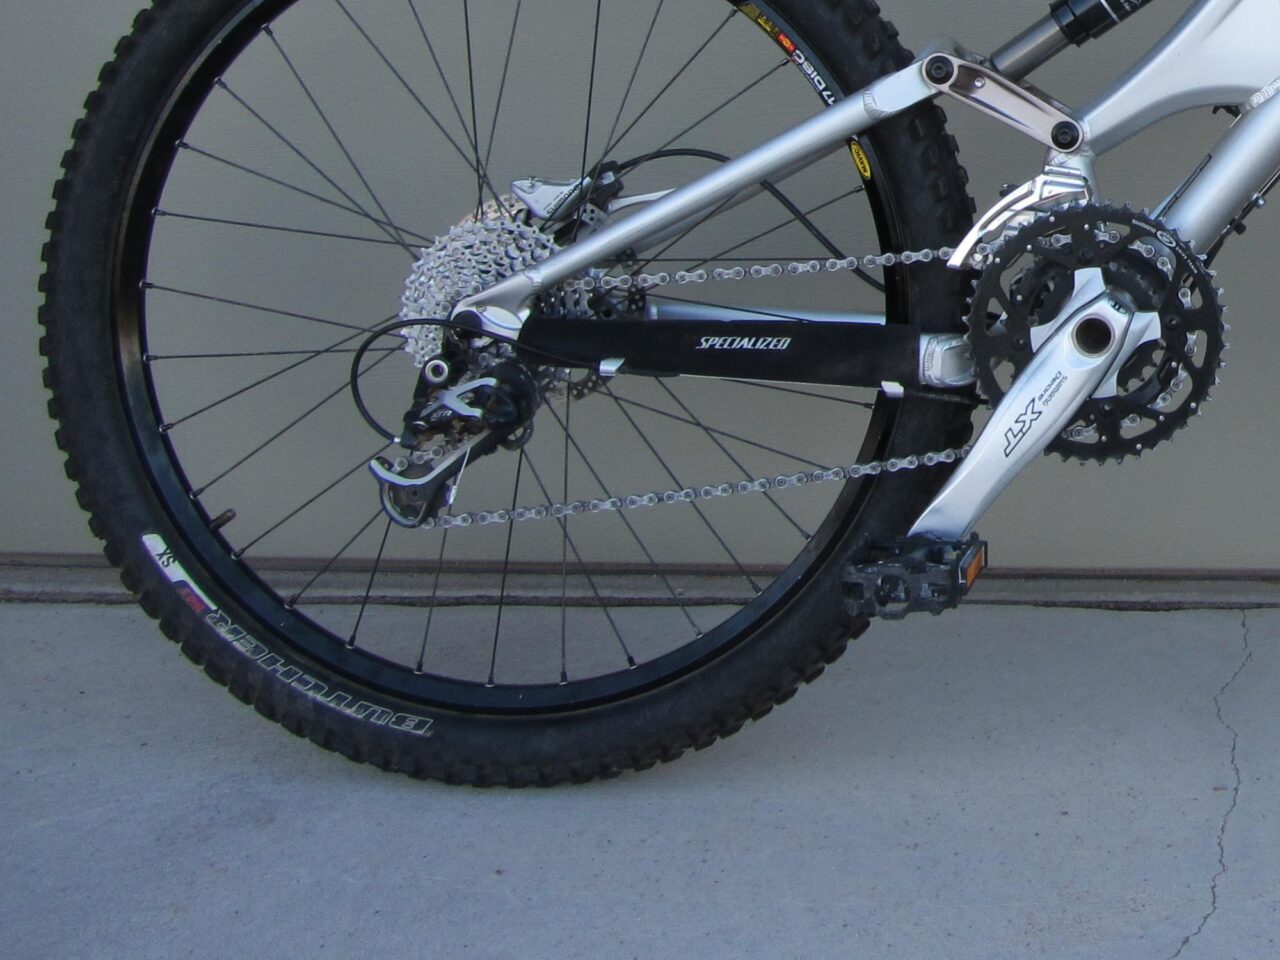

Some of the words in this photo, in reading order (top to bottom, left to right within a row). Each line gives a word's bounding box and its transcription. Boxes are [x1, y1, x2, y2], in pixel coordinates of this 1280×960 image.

[793, 49, 827, 91] DISC
[695, 336, 792, 350] SPECIALIZED
[1003, 396, 1043, 459] XT
[156, 548, 176, 568] SX
[206, 611, 434, 737] BUTCHER
